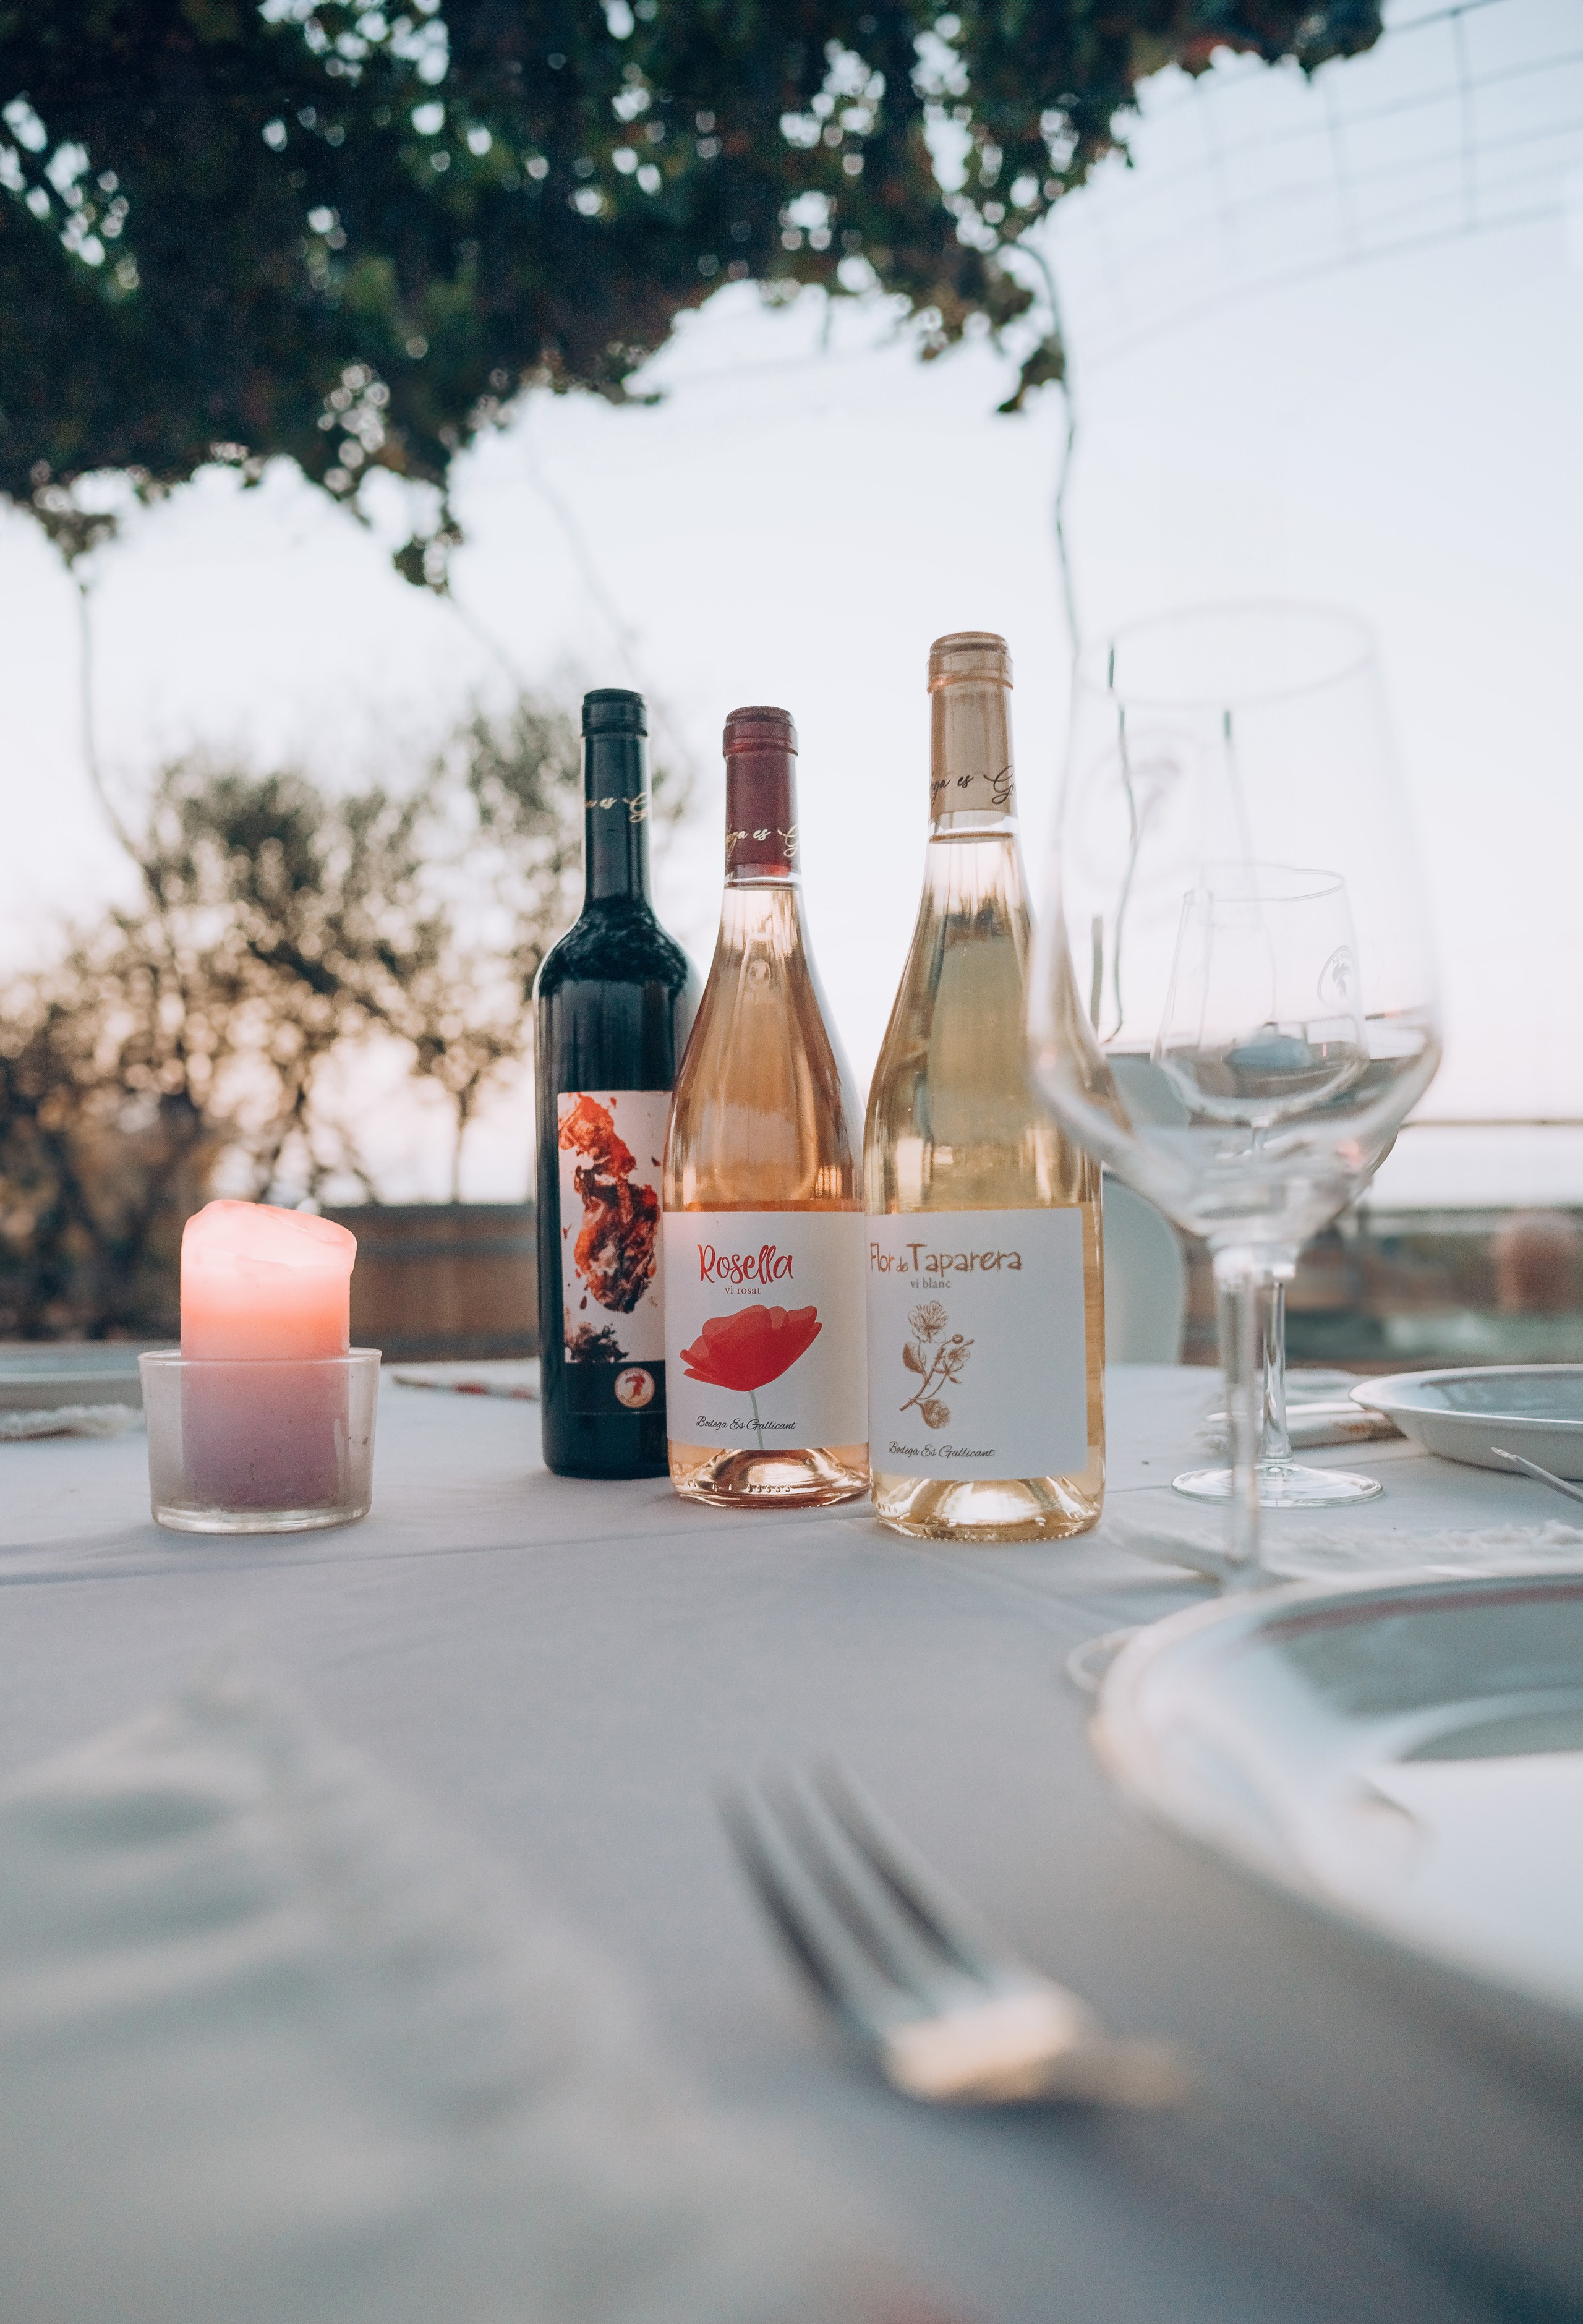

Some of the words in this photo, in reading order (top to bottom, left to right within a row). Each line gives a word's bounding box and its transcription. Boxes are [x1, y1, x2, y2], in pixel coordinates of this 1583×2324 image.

[957, 775, 974, 788] es
[599, 797, 618, 810] es
[753, 829, 772, 841] es
[697, 1244, 794, 1284] Rosella
[870, 1242, 895, 1272] Flor
[896, 1256, 909, 1272] de
[905, 1242, 1022, 1278] Taparera
[910, 1278, 919, 1288] vi
[923, 1277, 951, 1288] blanc
[725, 1285, 733, 1294] vi
[736, 1286, 761, 1294] rosat
[696, 1416, 728, 1431] Bodega
[729, 1418, 745, 1430] Es
[746, 1419, 797, 1431] Gallicant
[889, 1441, 918, 1458] Bodega
[921, 1444, 937, 1457] Es
[938, 1445, 995, 1459] Gallicant
